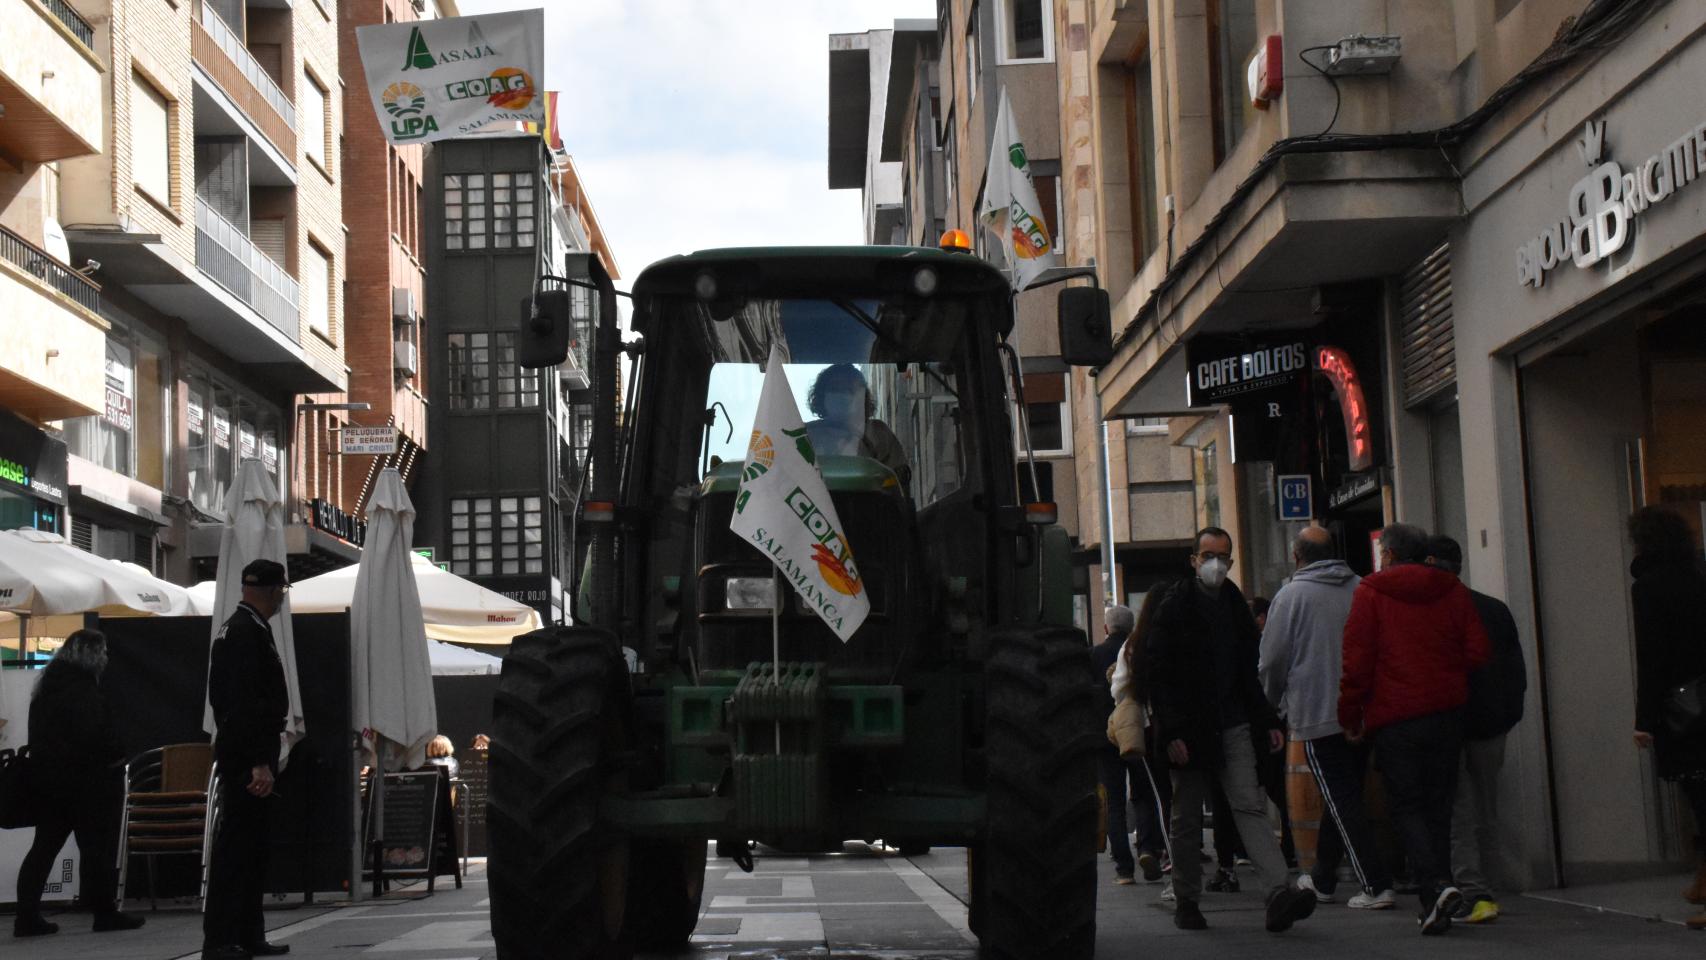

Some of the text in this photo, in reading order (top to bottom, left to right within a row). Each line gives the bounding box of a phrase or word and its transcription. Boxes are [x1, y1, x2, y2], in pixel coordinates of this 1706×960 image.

[438, 45, 496, 64] ASAJA
[447, 74, 526, 100] COAG
[391, 115, 439, 140] UPA
[1010, 196, 1048, 250] OAG
[1198, 356, 1239, 390] CAFE
[105, 390, 127, 412] QUILA
[1268, 402, 1281, 418] R
[345, 428, 392, 436] PELUQUERIA
[1284, 483, 1306, 499] CB
[785, 486, 859, 585] COAG
[751, 527, 845, 631] SALAMANCA
[527, 590, 547, 600] ROJO
